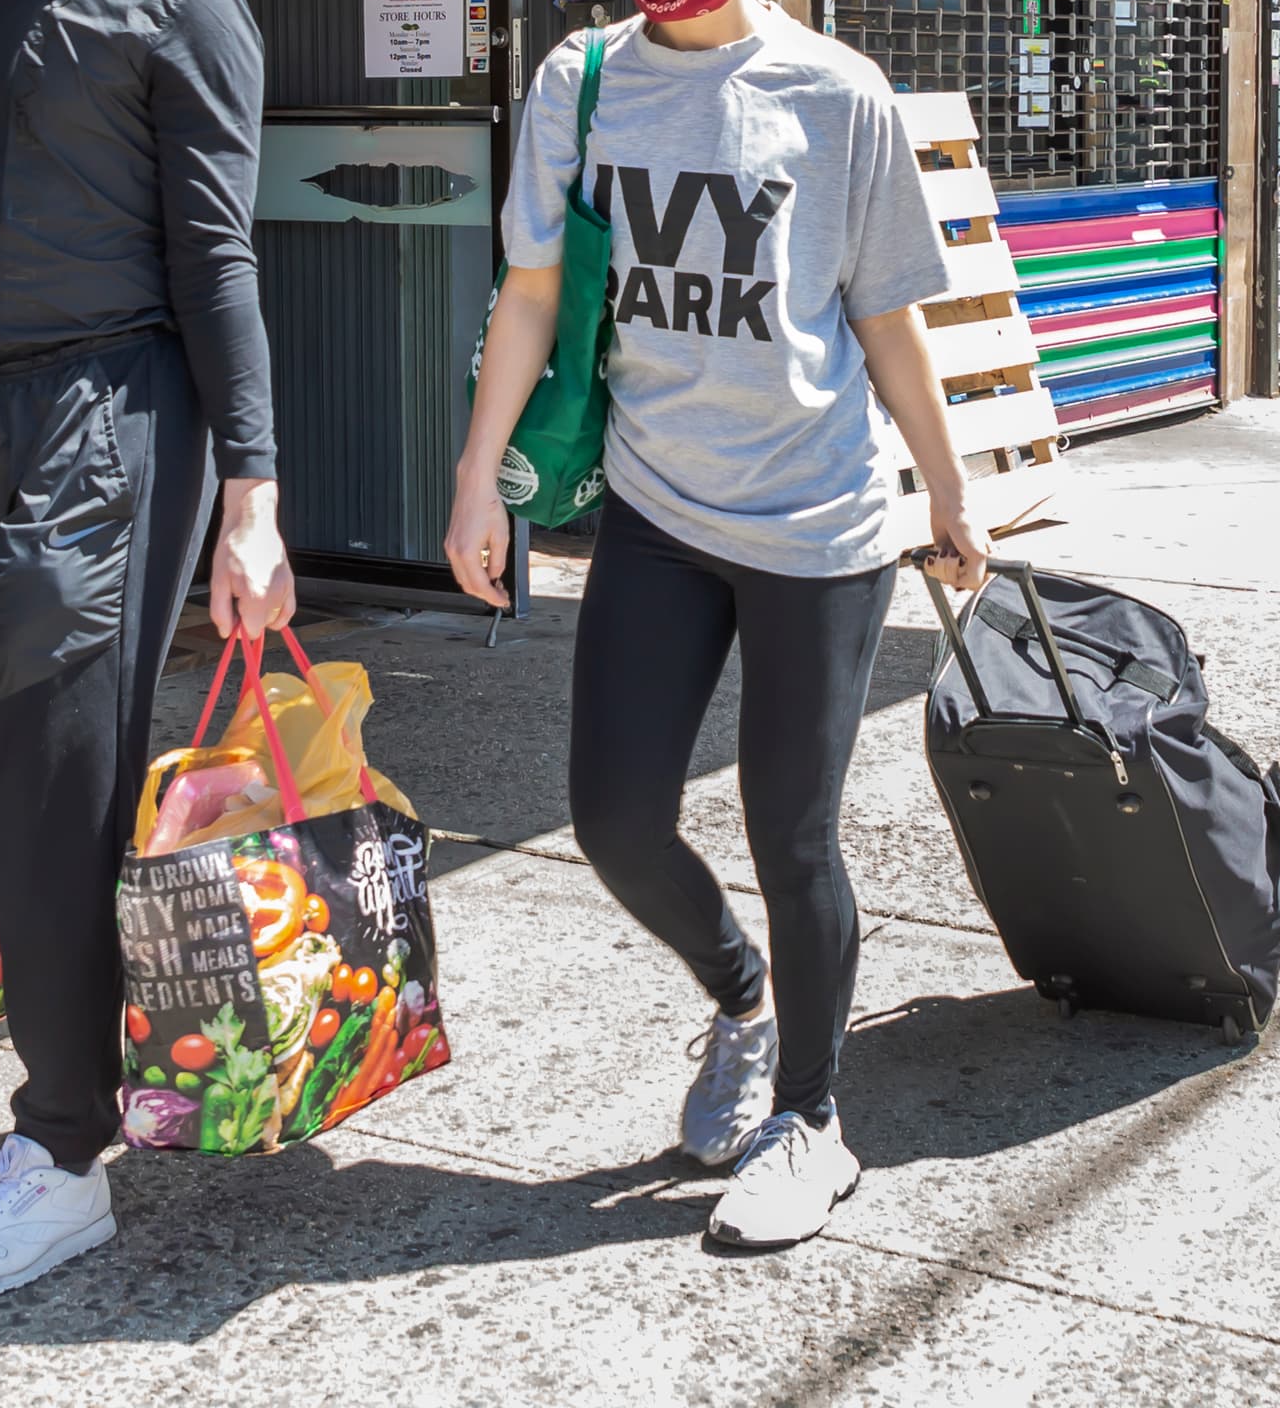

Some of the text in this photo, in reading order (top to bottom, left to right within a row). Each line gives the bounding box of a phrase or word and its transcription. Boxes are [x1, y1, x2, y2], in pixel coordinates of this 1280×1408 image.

[379, 11, 446, 21] STORE HOURS
[593, 164, 795, 275] IVY
[149, 851, 234, 891] GROWN
[181, 881, 241, 912] HOME
[187, 912, 243, 941] MADE
[192, 944, 249, 973] MEALS
